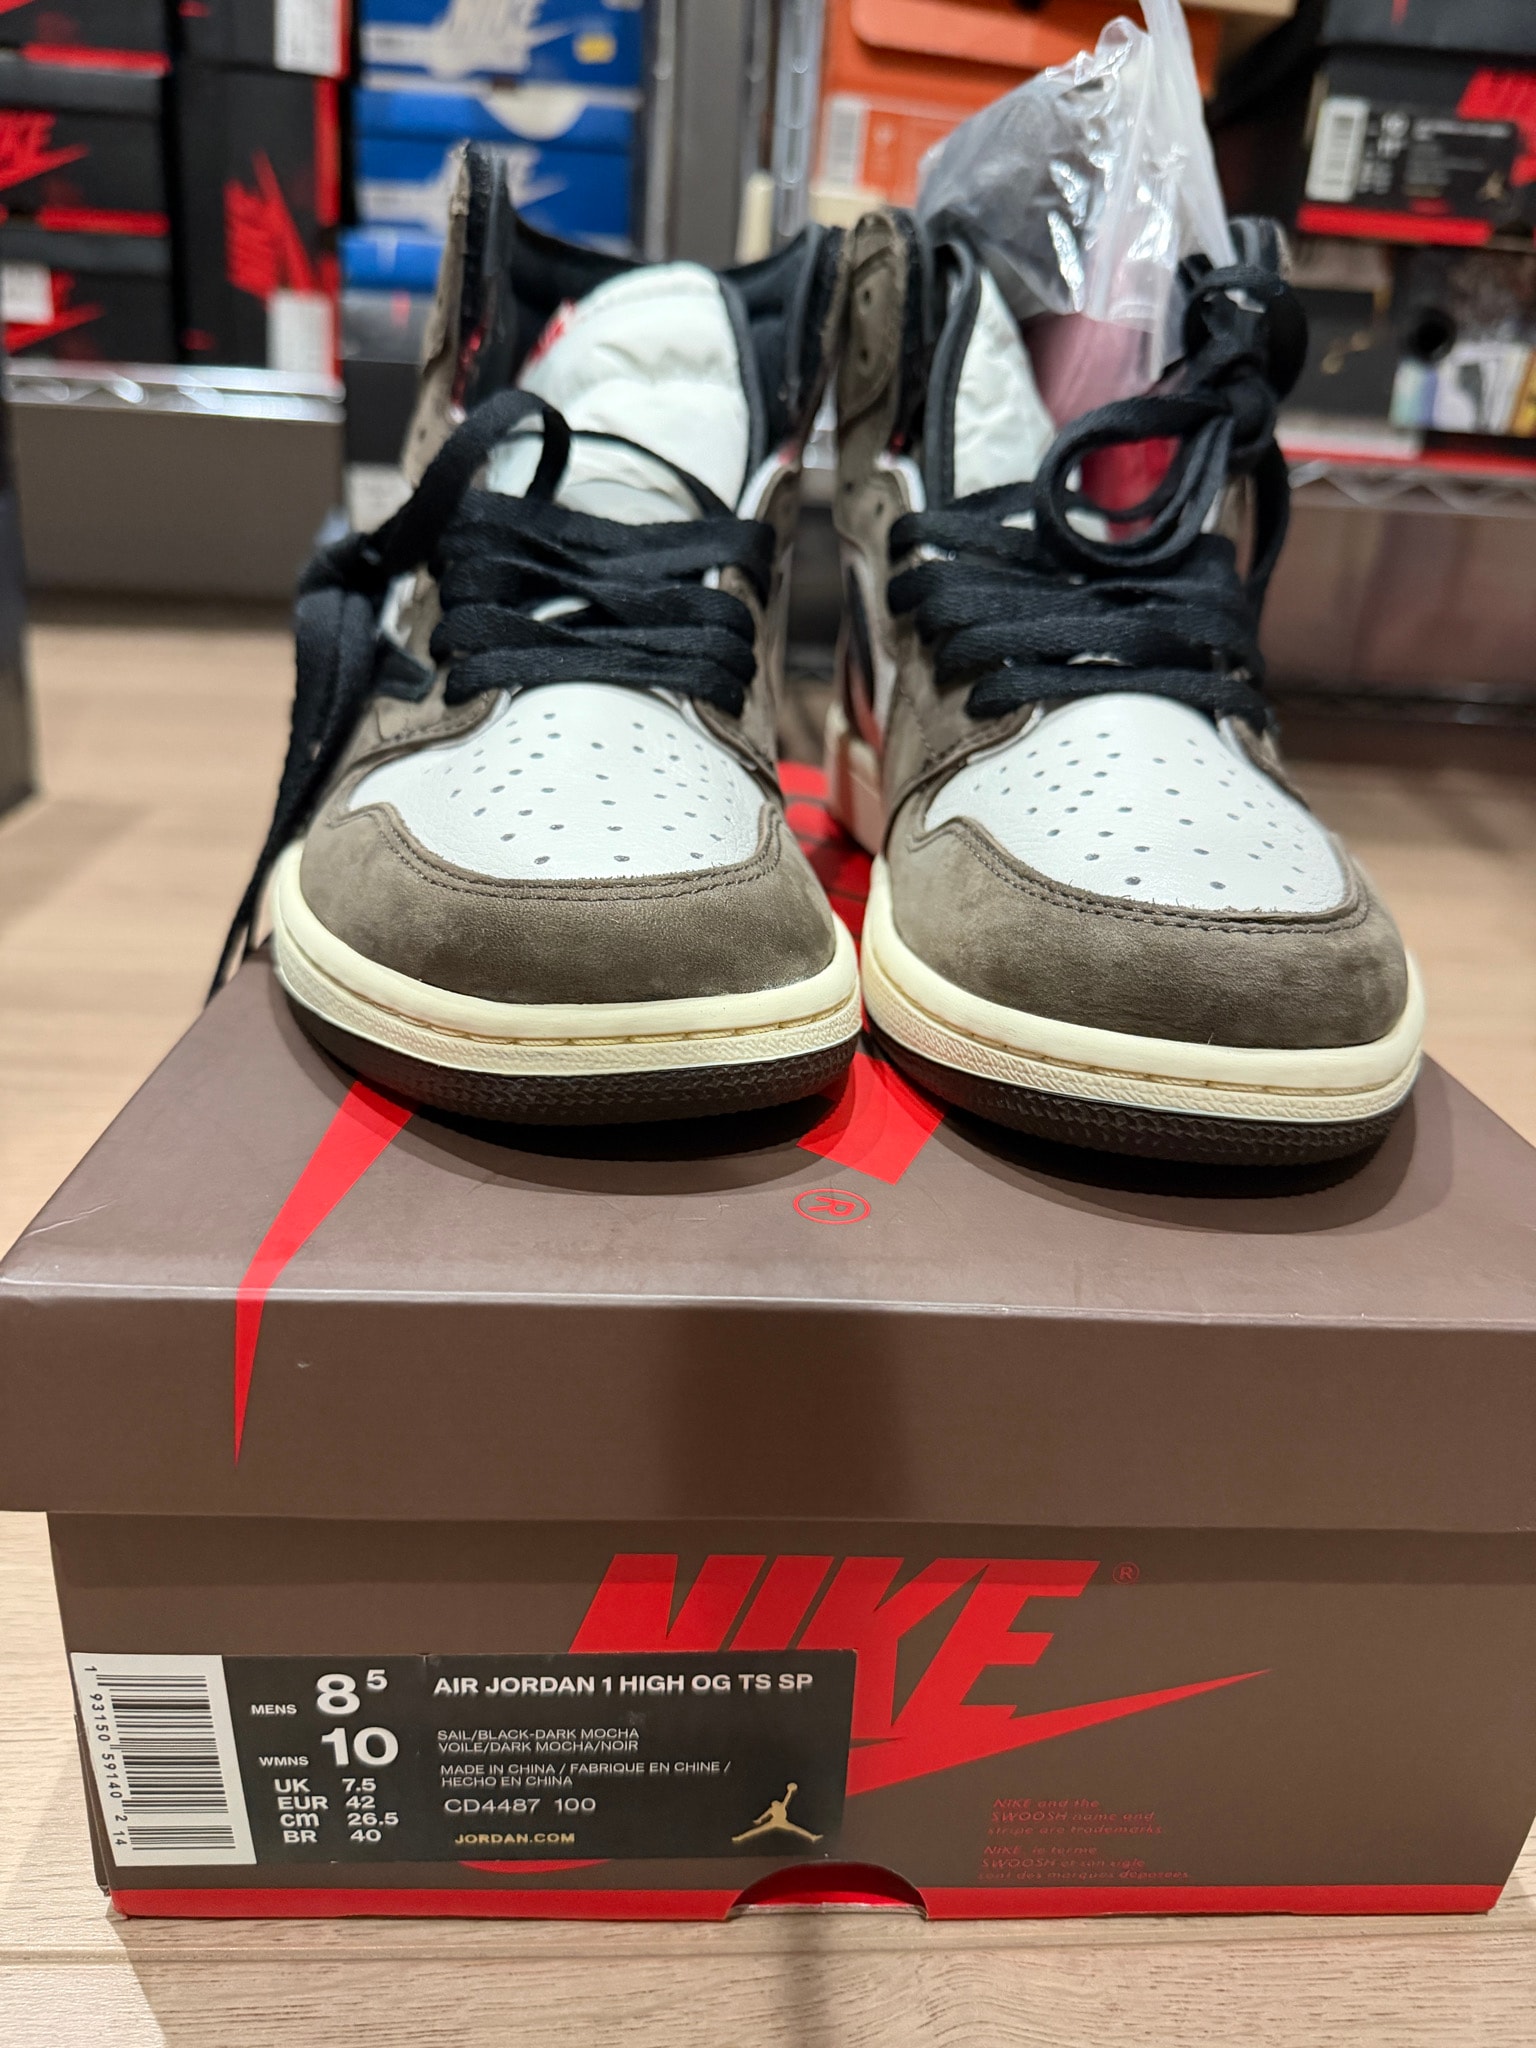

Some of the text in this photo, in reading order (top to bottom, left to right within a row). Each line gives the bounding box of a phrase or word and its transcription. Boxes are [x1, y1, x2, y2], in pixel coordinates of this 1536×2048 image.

[434, 1674, 812, 1694] AIR JORDAN 1 HIGH OG TS SP
[251, 1669, 387, 1715] MENS 8 5
[438, 1728, 639, 1741] SAIL/BLACK-DARK MOCHA
[90, 1693, 111, 1742] 93150
[102, 1753, 123, 1799] 59140
[259, 1727, 398, 1766] WMNS 10
[439, 1740, 638, 1753] VOILE/DARK MOCHA/NOIR
[441, 1765, 484, 1775] MADE
[490, 1765, 503, 1775] IN
[508, 1764, 555, 1774] CHINA
[571, 1763, 644, 1774] FABRIQUE
[650, 1763, 669, 1773] EN
[675, 1762, 719, 1772] CHINE
[275, 1778, 376, 1793] UK 7.5
[442, 1776, 572, 1787] HECHO EN CHINA
[278, 1796, 375, 1810] EUR 42
[445, 1798, 595, 1813] CD4487 100
[993, 1799, 1099, 1809] NIKE and the
[280, 1812, 398, 1827] cm 26.5
[991, 1811, 1155, 1822] SWOOSH name and
[284, 1829, 381, 1843] BR 40
[455, 1833, 574, 1844] JORDAN.COM
[982, 1859, 1056, 1869] SWOOSH
